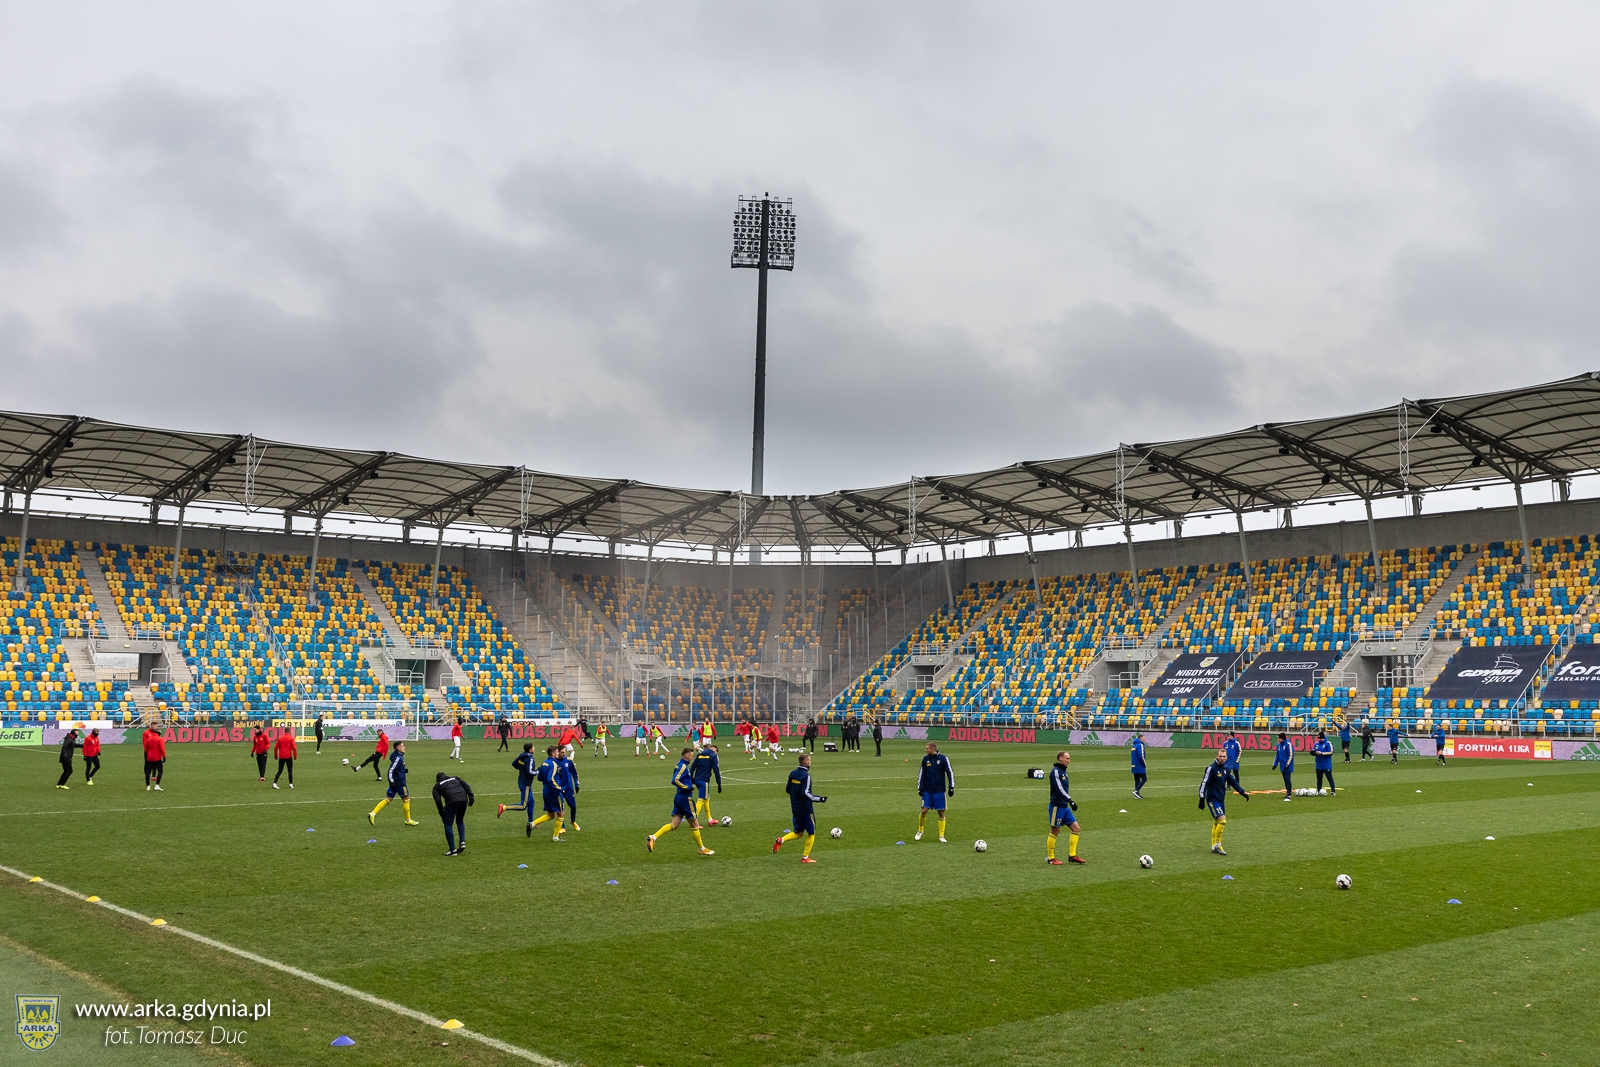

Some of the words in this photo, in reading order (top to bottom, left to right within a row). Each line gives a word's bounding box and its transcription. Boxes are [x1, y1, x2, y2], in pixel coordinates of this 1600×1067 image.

[152, 642, 158, 650] 9
[1364, 643, 1372, 652] G
[430, 649, 439, 657] 10
[1107, 650, 1114, 659] G
[1175, 669, 1205, 677] NIGDY
[1457, 669, 1523, 677] GDYNIA
[1162, 677, 1220, 686] ZOSTANIESZ
[1481, 674, 1518, 684] sport
[1171, 687, 1195, 695] SAM
[948, 728, 1036, 743] ADIDAS.COM
[1458, 743, 1504, 753] FORTUNA
[1514, 745, 1530, 753] LIGA
